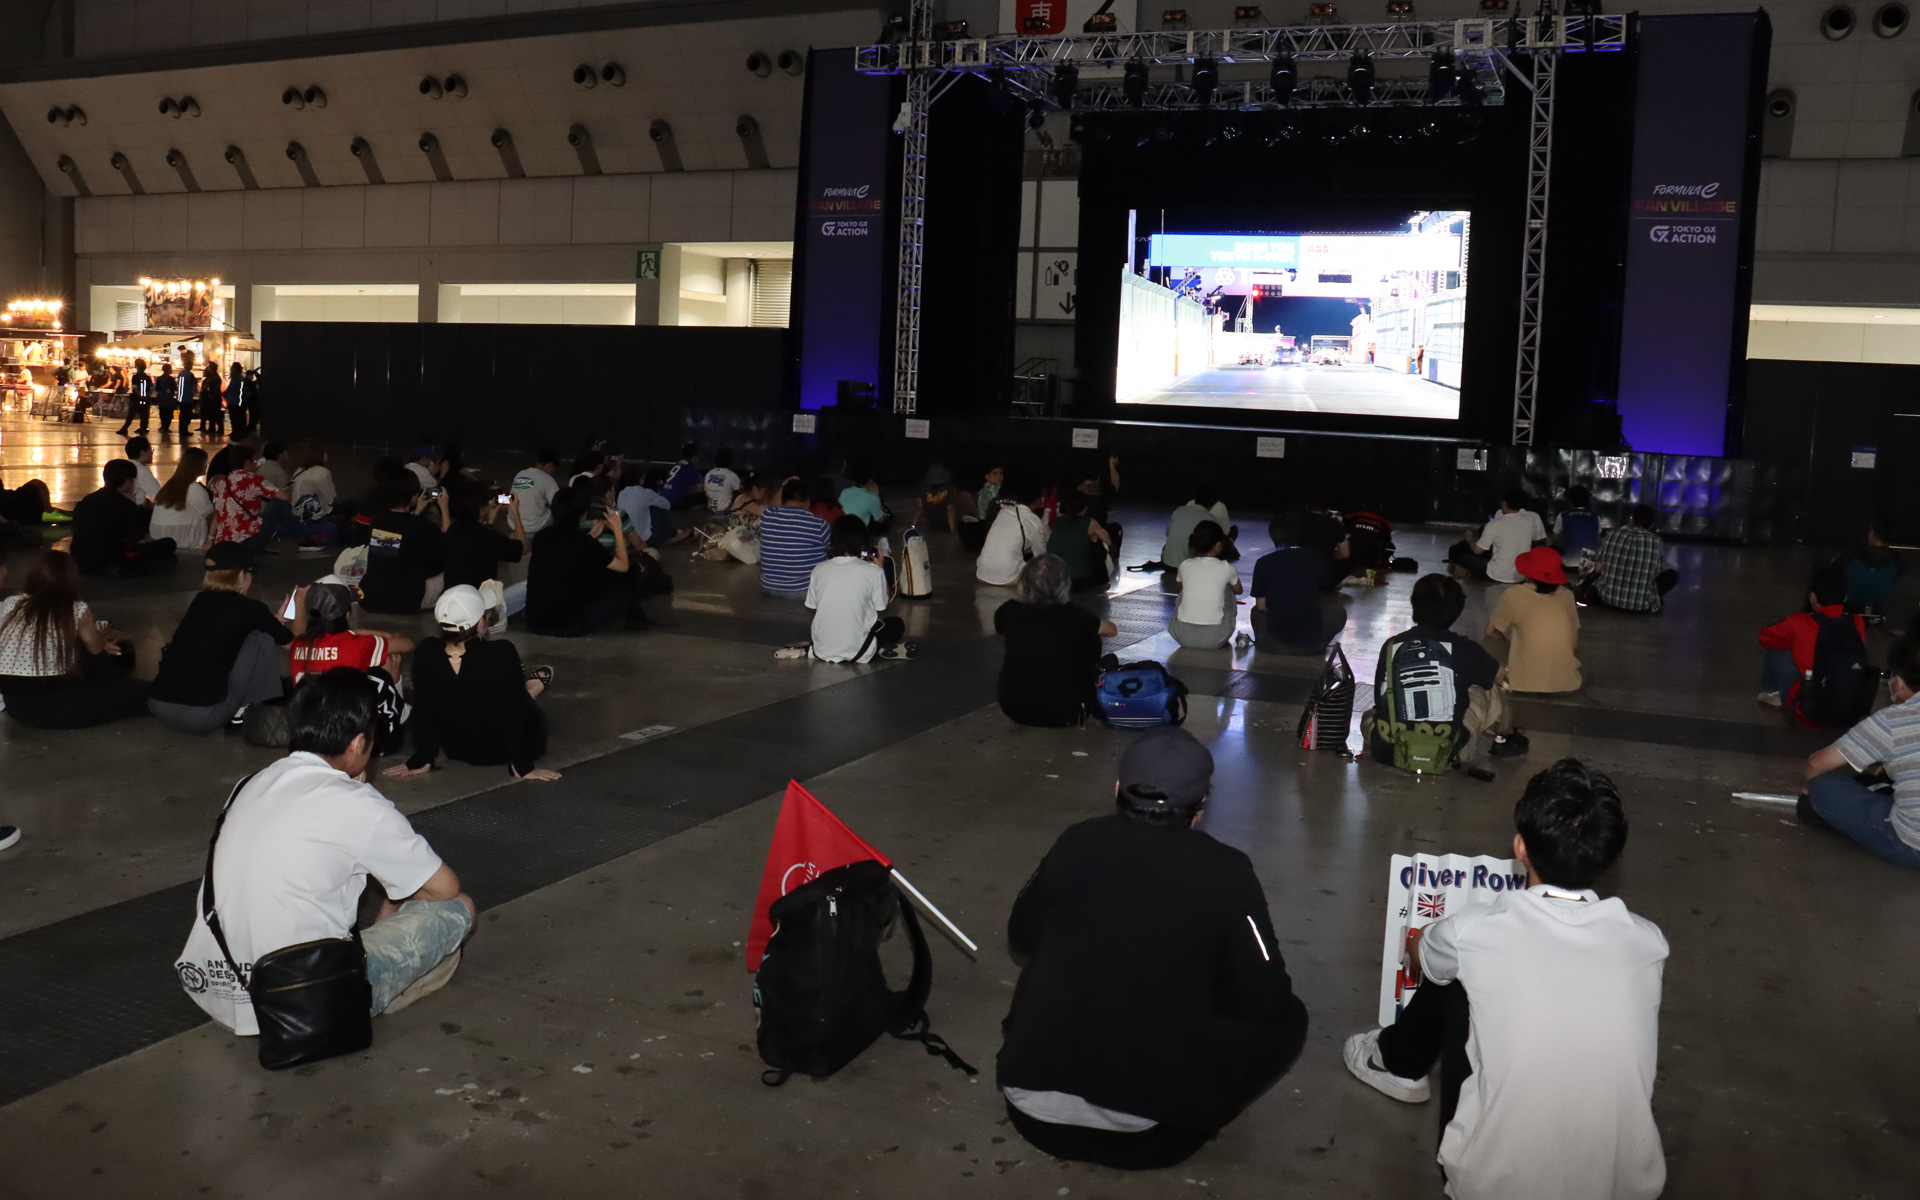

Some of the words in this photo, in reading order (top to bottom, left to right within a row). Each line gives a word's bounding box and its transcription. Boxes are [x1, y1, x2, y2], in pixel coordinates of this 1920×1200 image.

[812, 201, 834, 210] FAN
[835, 200, 882, 210] VILLAGE
[1635, 201, 1668, 212] FAN
[1670, 201, 1736, 213] VILLAGE
[836, 228, 868, 236] ACTION
[1671, 234, 1717, 244] ACTION
[1210, 251, 1251, 261] TOKYO
[665, 465, 681, 484] 9
